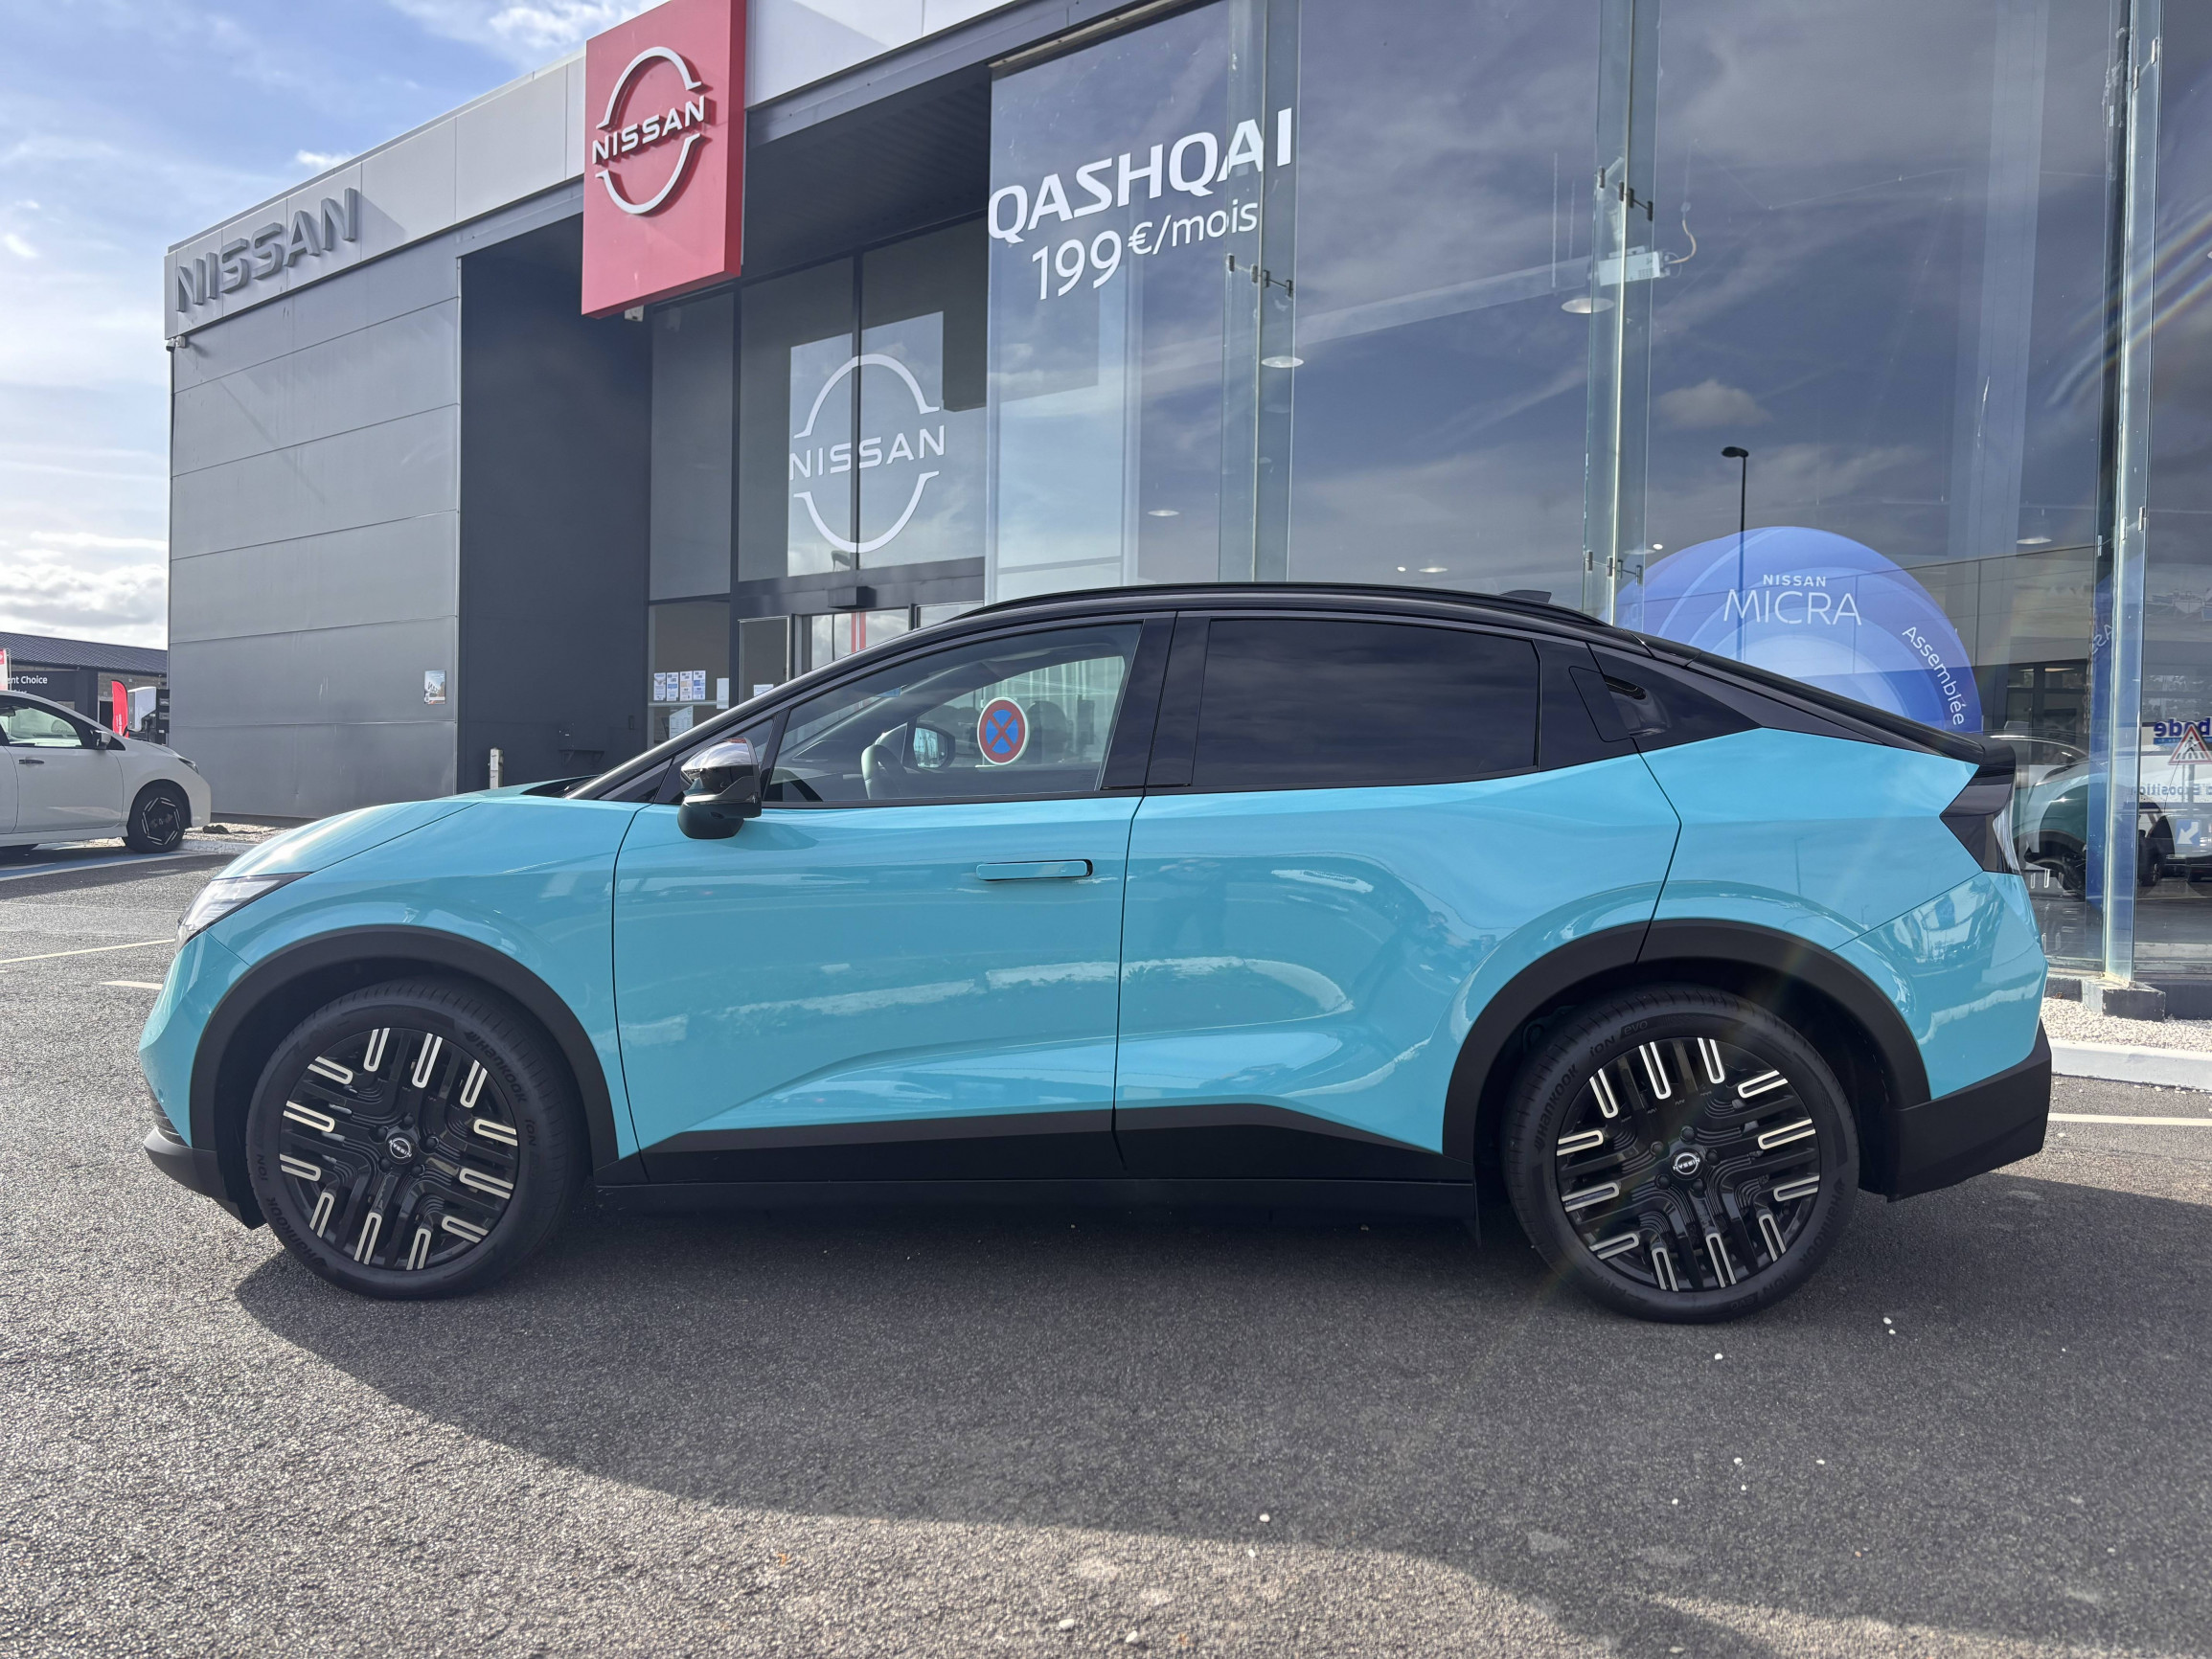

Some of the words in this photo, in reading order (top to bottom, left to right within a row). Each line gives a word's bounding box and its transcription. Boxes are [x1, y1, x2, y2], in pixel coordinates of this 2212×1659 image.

[592, 96, 705, 164] NISSAN
[988, 107, 1292, 244] QASHQAI
[175, 187, 358, 312] NISSAN
[788, 424, 946, 481] NISSAN
[1723, 589, 1862, 625] MICRA
[1763, 574, 1826, 587] NISSAN
[20, 675, 48, 684] Choice
[1902, 625, 1967, 726] Assemblée
